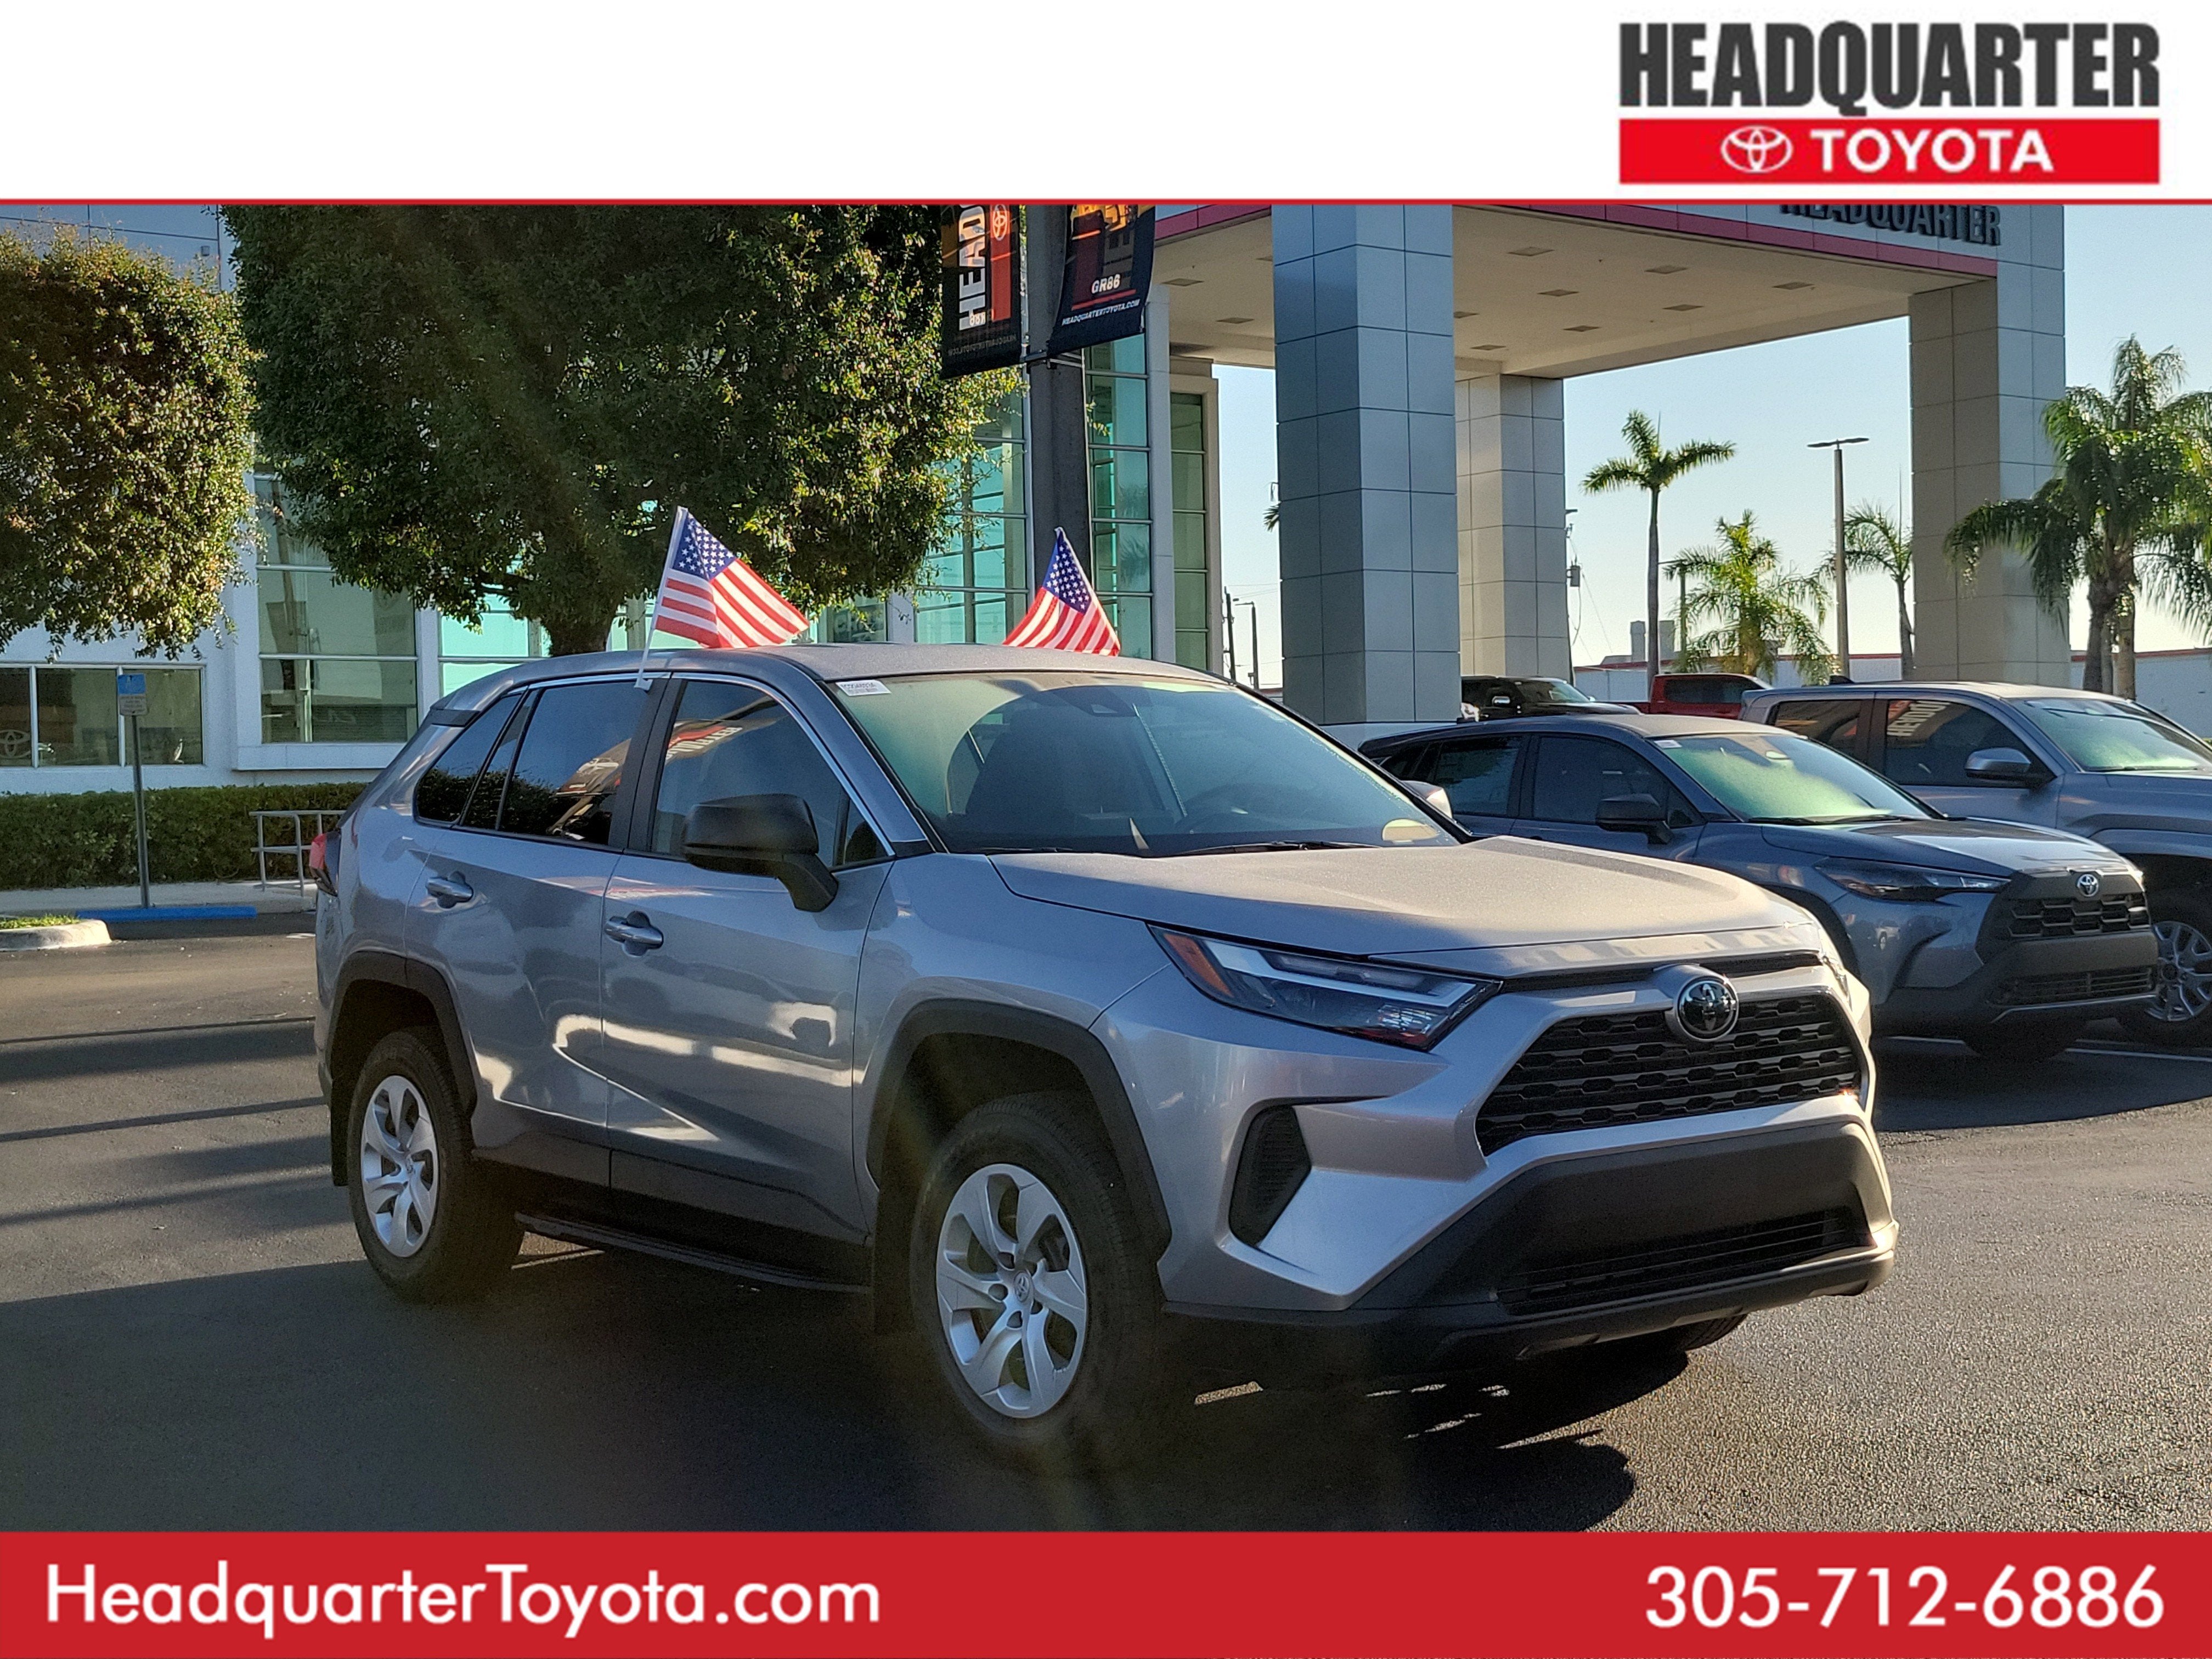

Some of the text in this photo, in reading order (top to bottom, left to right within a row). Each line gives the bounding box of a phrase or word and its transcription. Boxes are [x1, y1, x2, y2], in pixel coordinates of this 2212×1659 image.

[1780, 205, 2000, 246] QUARTER
[959, 205, 985, 330] HEAD
[1091, 274, 1120, 294] GR86
[1062, 298, 1141, 326] HEADQUARTERTOYOTA.COM
